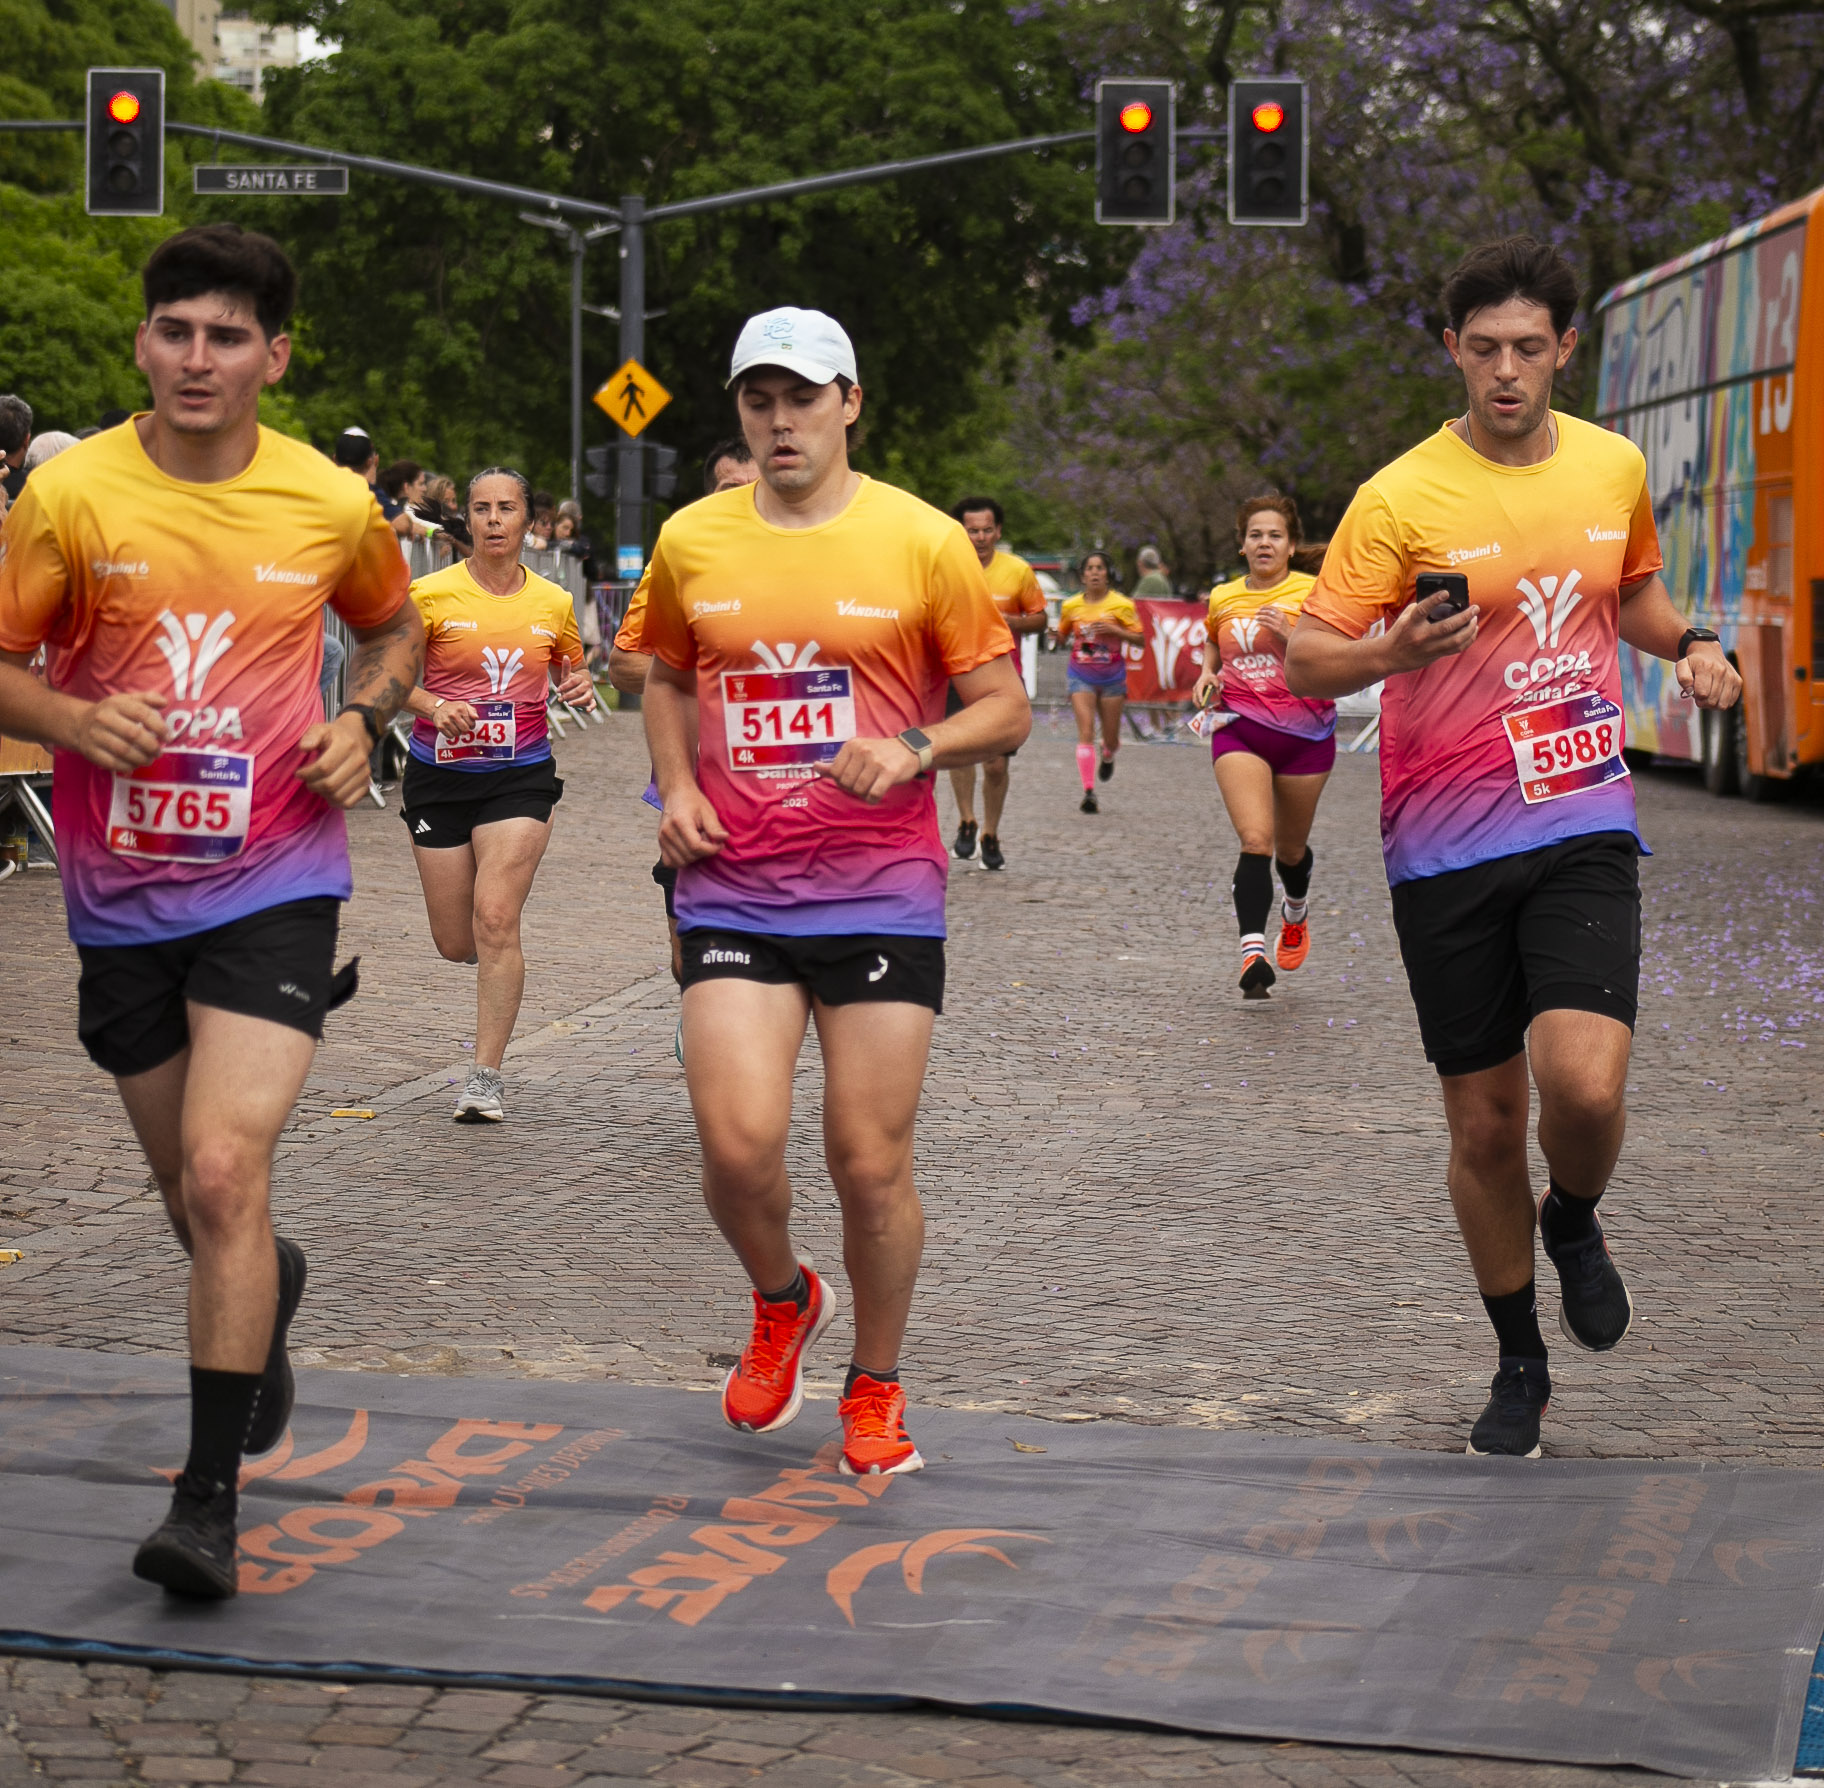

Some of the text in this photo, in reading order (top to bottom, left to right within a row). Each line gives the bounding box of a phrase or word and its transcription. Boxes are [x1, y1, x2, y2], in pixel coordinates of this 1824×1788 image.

[226, 171, 317, 190] SANTA FE
[1585, 524, 1627, 543] VANDALIA
[253, 562, 319, 586] VANDALIA
[835, 598, 900, 620] VANDALIA
[1231, 653, 1276, 672] COPA
[1503, 650, 1593, 691] COPA
[806, 683, 843, 694] Santa Fe
[1583, 708, 1606, 718] Santa
[1606, 705, 1614, 713] Fe
[164, 705, 244, 744] OPA
[742, 702, 835, 742] 5141
[441, 750, 454, 759] 4k
[738, 749, 755, 764] 4k
[1532, 723, 1613, 774] 5988
[200, 768, 241, 782] Santa Fe
[1533, 782, 1551, 796] 5k
[127, 786, 231, 832] 5765
[782, 798, 808, 808] 2025
[117, 829, 138, 848] 4k
